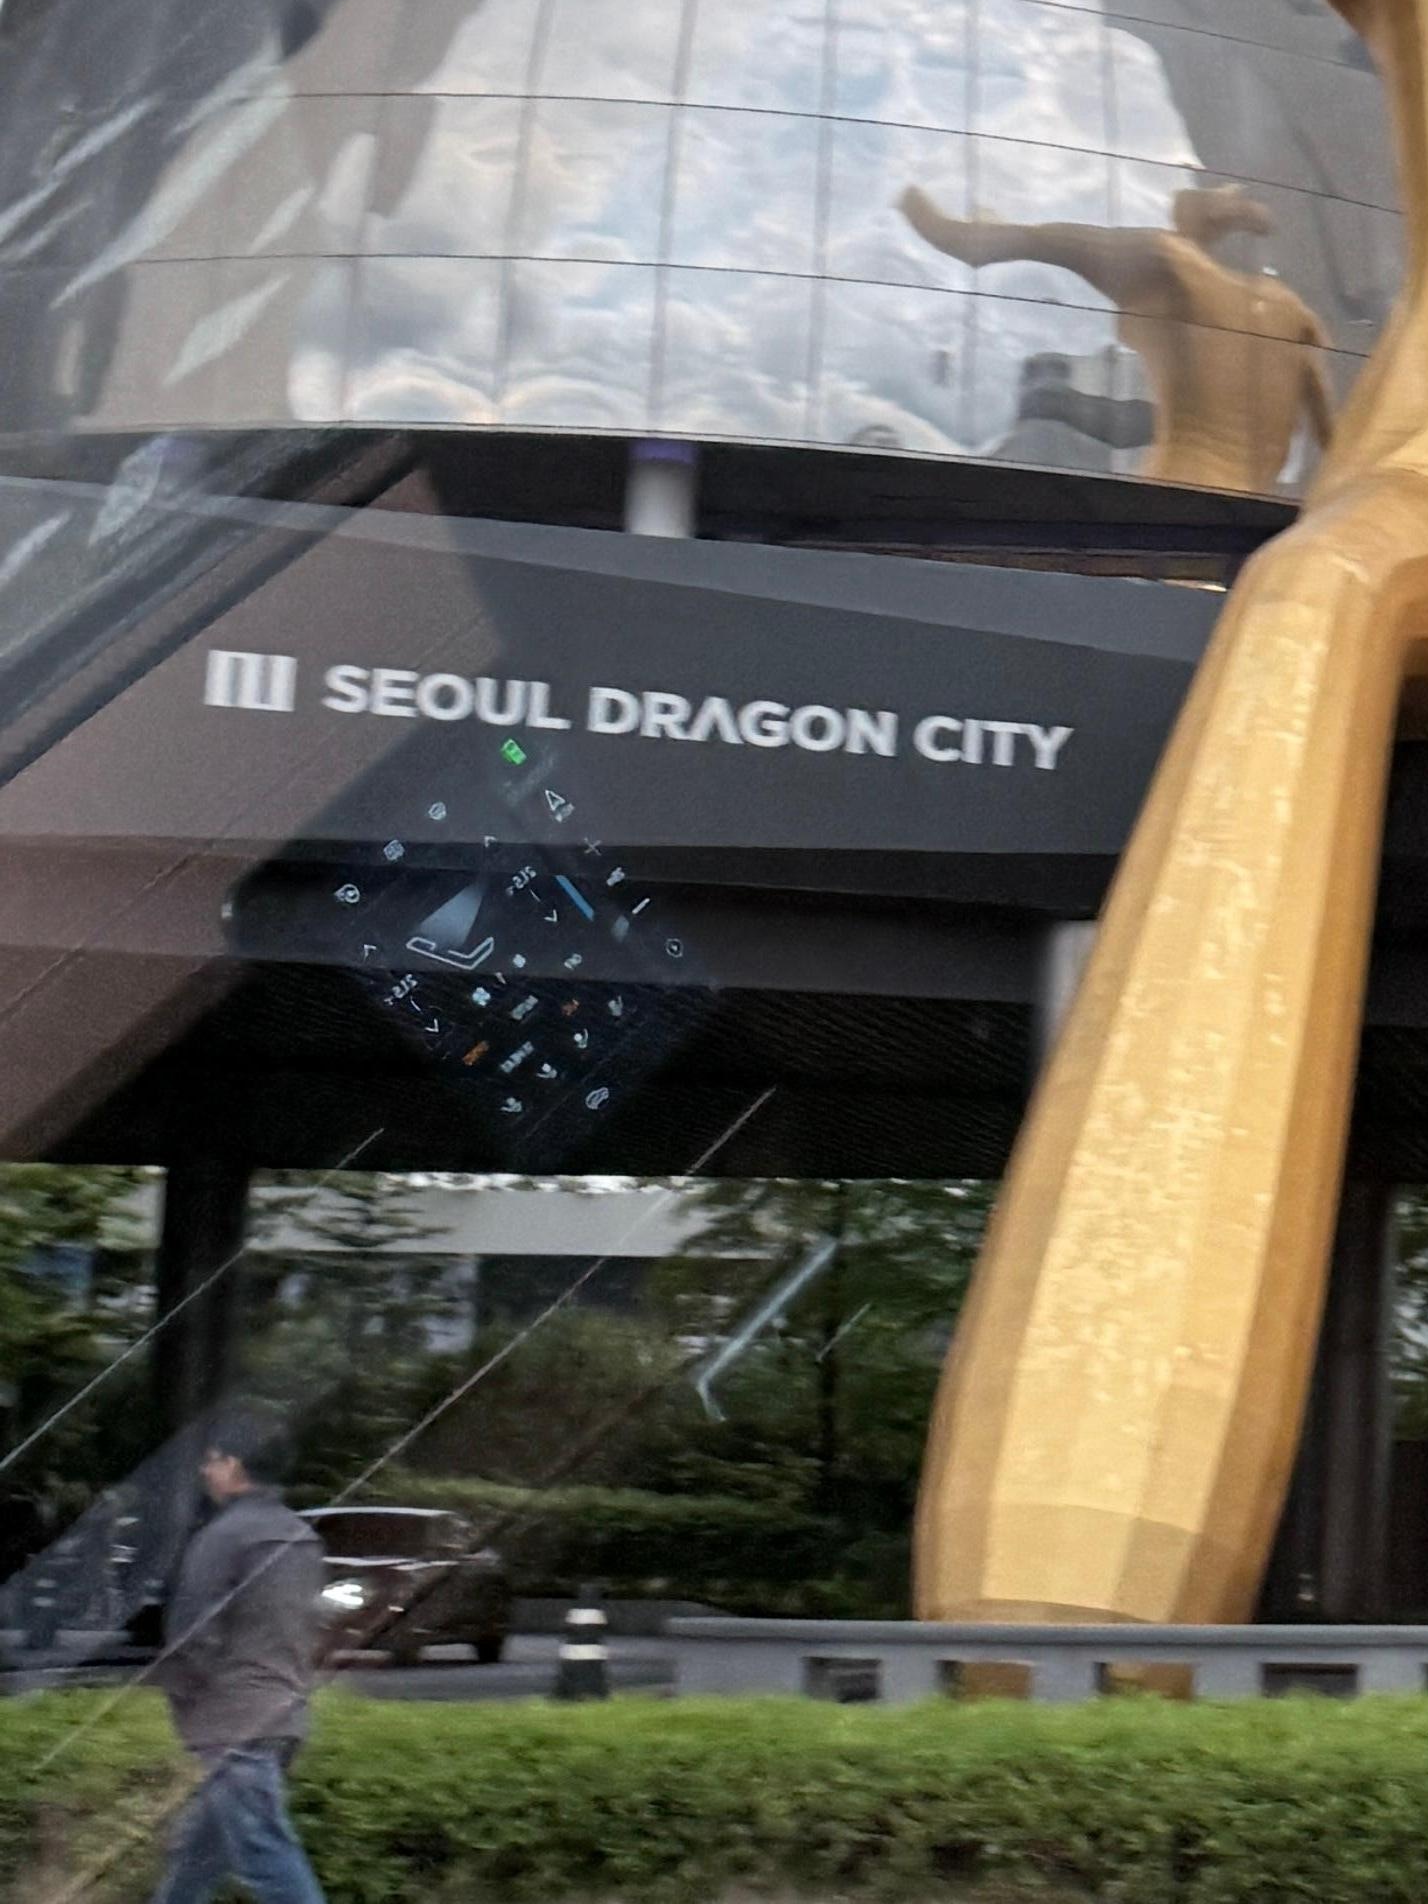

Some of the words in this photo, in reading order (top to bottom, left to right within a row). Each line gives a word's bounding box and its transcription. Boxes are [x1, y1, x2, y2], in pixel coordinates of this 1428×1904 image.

[322, 664, 572, 730] SEOUL
[587, 686, 898, 757] DRAGON
[913, 715, 1075, 770] CITY
